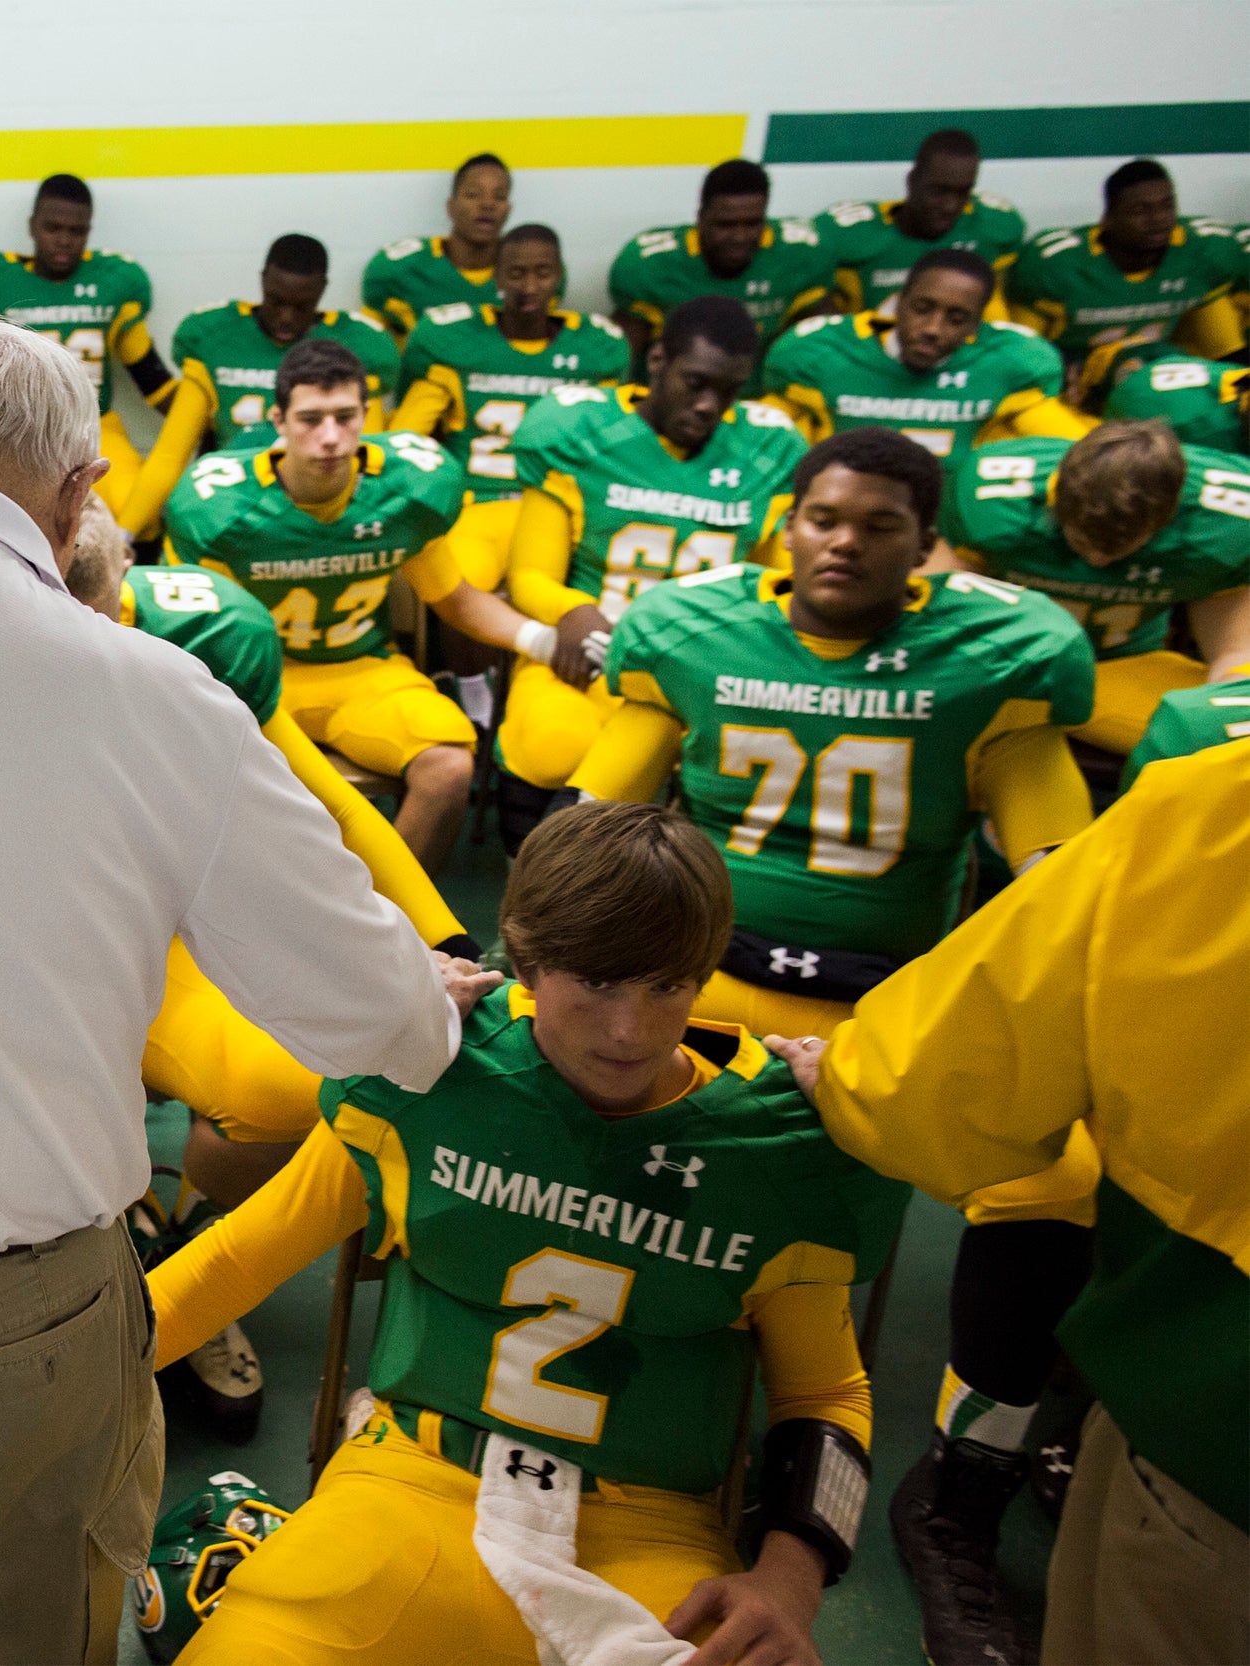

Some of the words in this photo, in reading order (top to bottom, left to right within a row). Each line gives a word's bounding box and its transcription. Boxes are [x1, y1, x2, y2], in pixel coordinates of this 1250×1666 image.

[836, 395, 994, 422] SUMMERVILLE
[606, 483, 752, 527] SUMMERVILLE
[250, 547, 407, 581] SUMMERVILLE
[271, 574, 393, 651] 42
[715, 674, 935, 721] SUMMERVILLE
[718, 723, 915, 878] 70
[430, 1144, 755, 1273] SUMMERVILLE
[481, 1246, 636, 1446] 2
